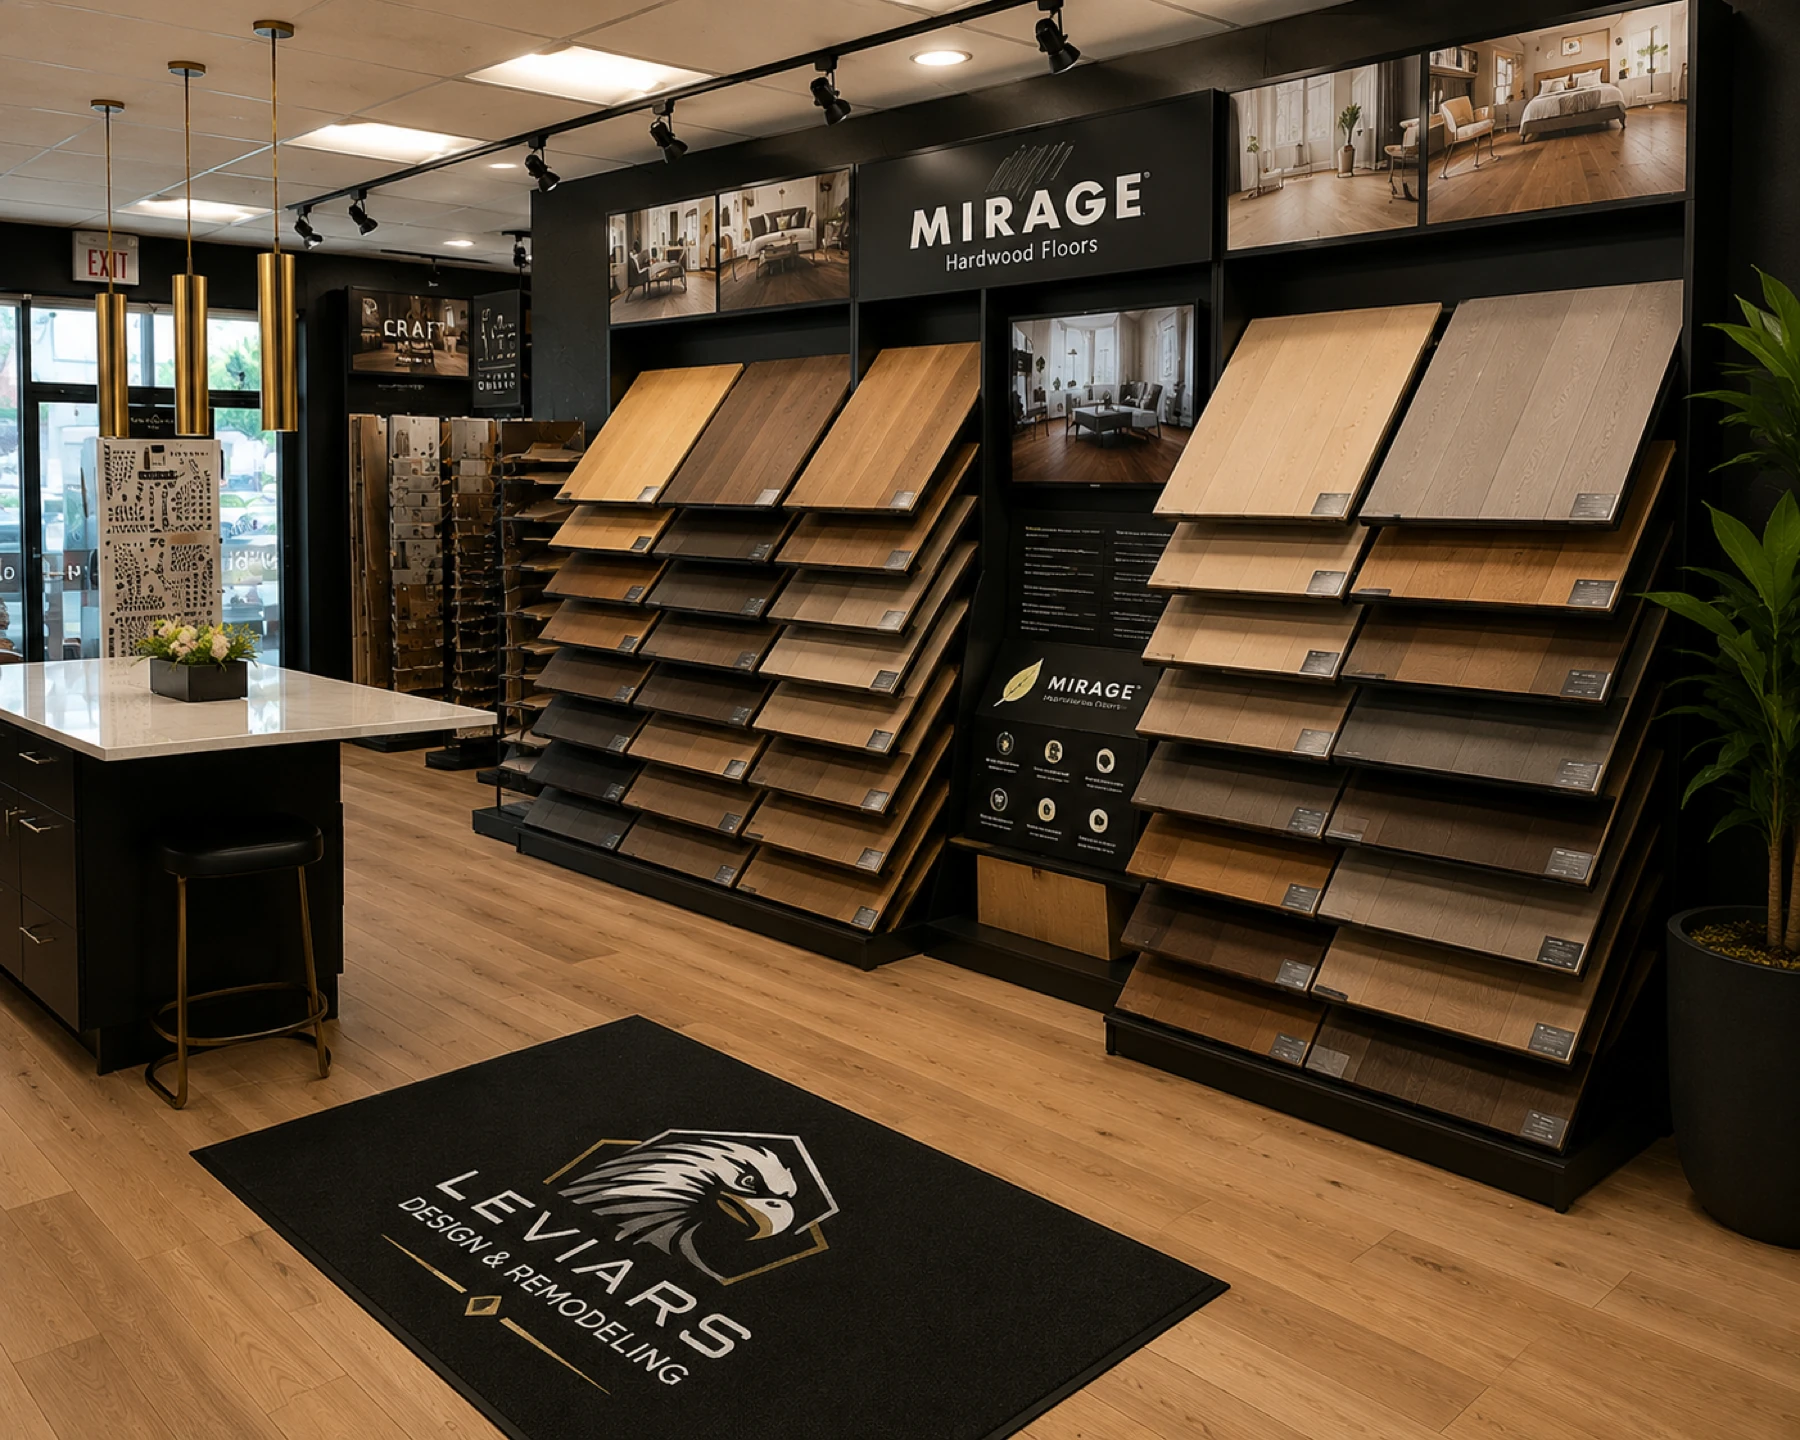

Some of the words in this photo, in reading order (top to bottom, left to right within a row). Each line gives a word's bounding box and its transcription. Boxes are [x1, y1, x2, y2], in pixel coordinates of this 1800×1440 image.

[909, 172, 1142, 250] MIRAGE
[88, 248, 128, 279] EXIT
[945, 243, 1034, 272] Hardwood
[1042, 237, 1098, 260] Floors
[1047, 675, 1136, 701] MIRAGE
[397, 1194, 492, 1255] DESIGN
[482, 1250, 511, 1270] &
[502, 1263, 690, 1387] REMODELING
[435, 1169, 752, 1360] LEVIARS
